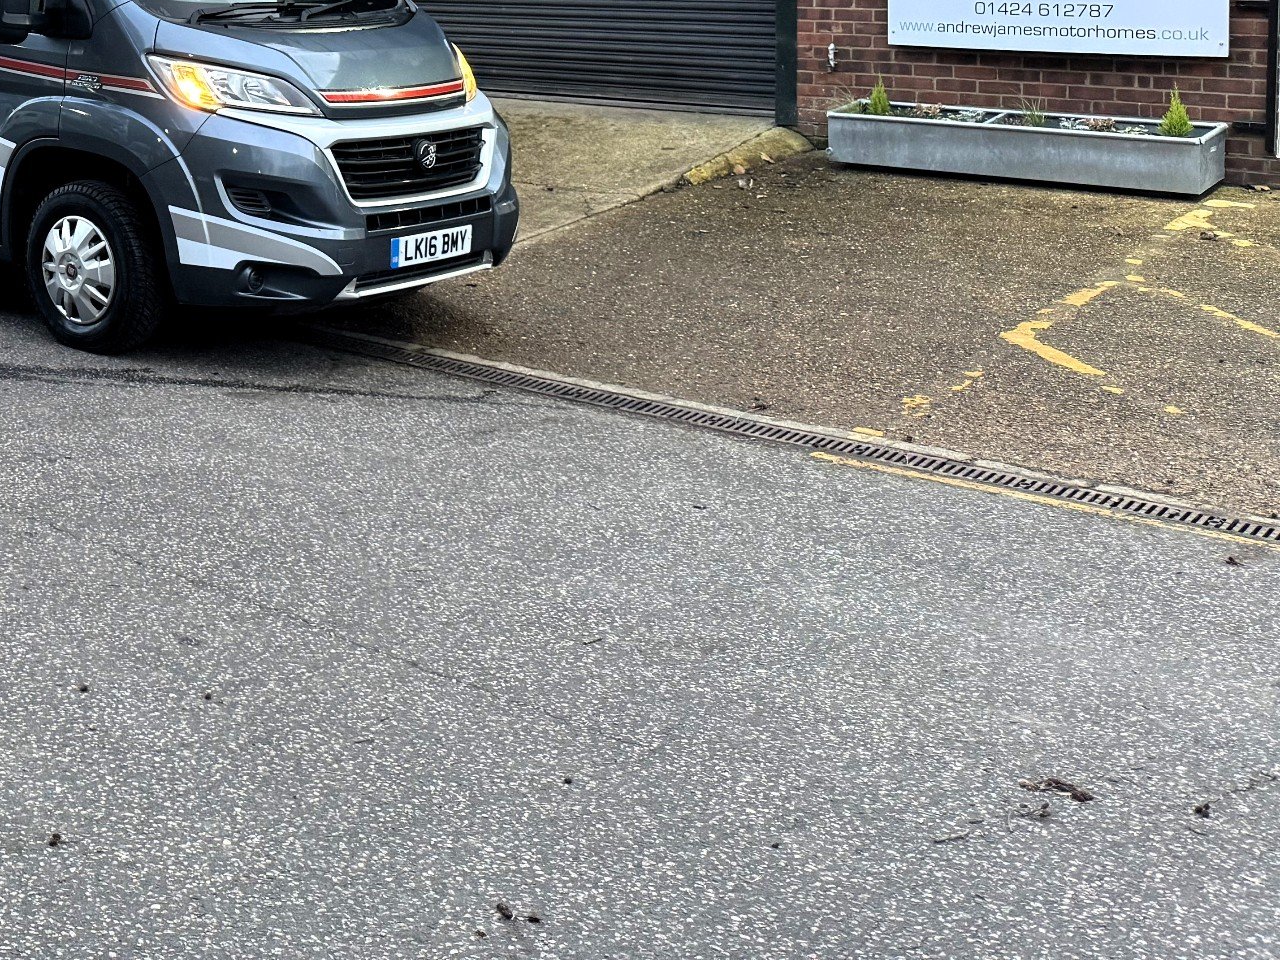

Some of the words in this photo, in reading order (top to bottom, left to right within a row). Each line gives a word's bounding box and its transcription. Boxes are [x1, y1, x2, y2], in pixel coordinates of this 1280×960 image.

[974, 1, 1033, 16] 01424
[1038, 3, 1114, 18] 612787
[899, 20, 1209, 41] www.andrewjamesmotorhomes.co.uk
[404, 236, 437, 261] LK16
[441, 229, 467, 254] BMY
